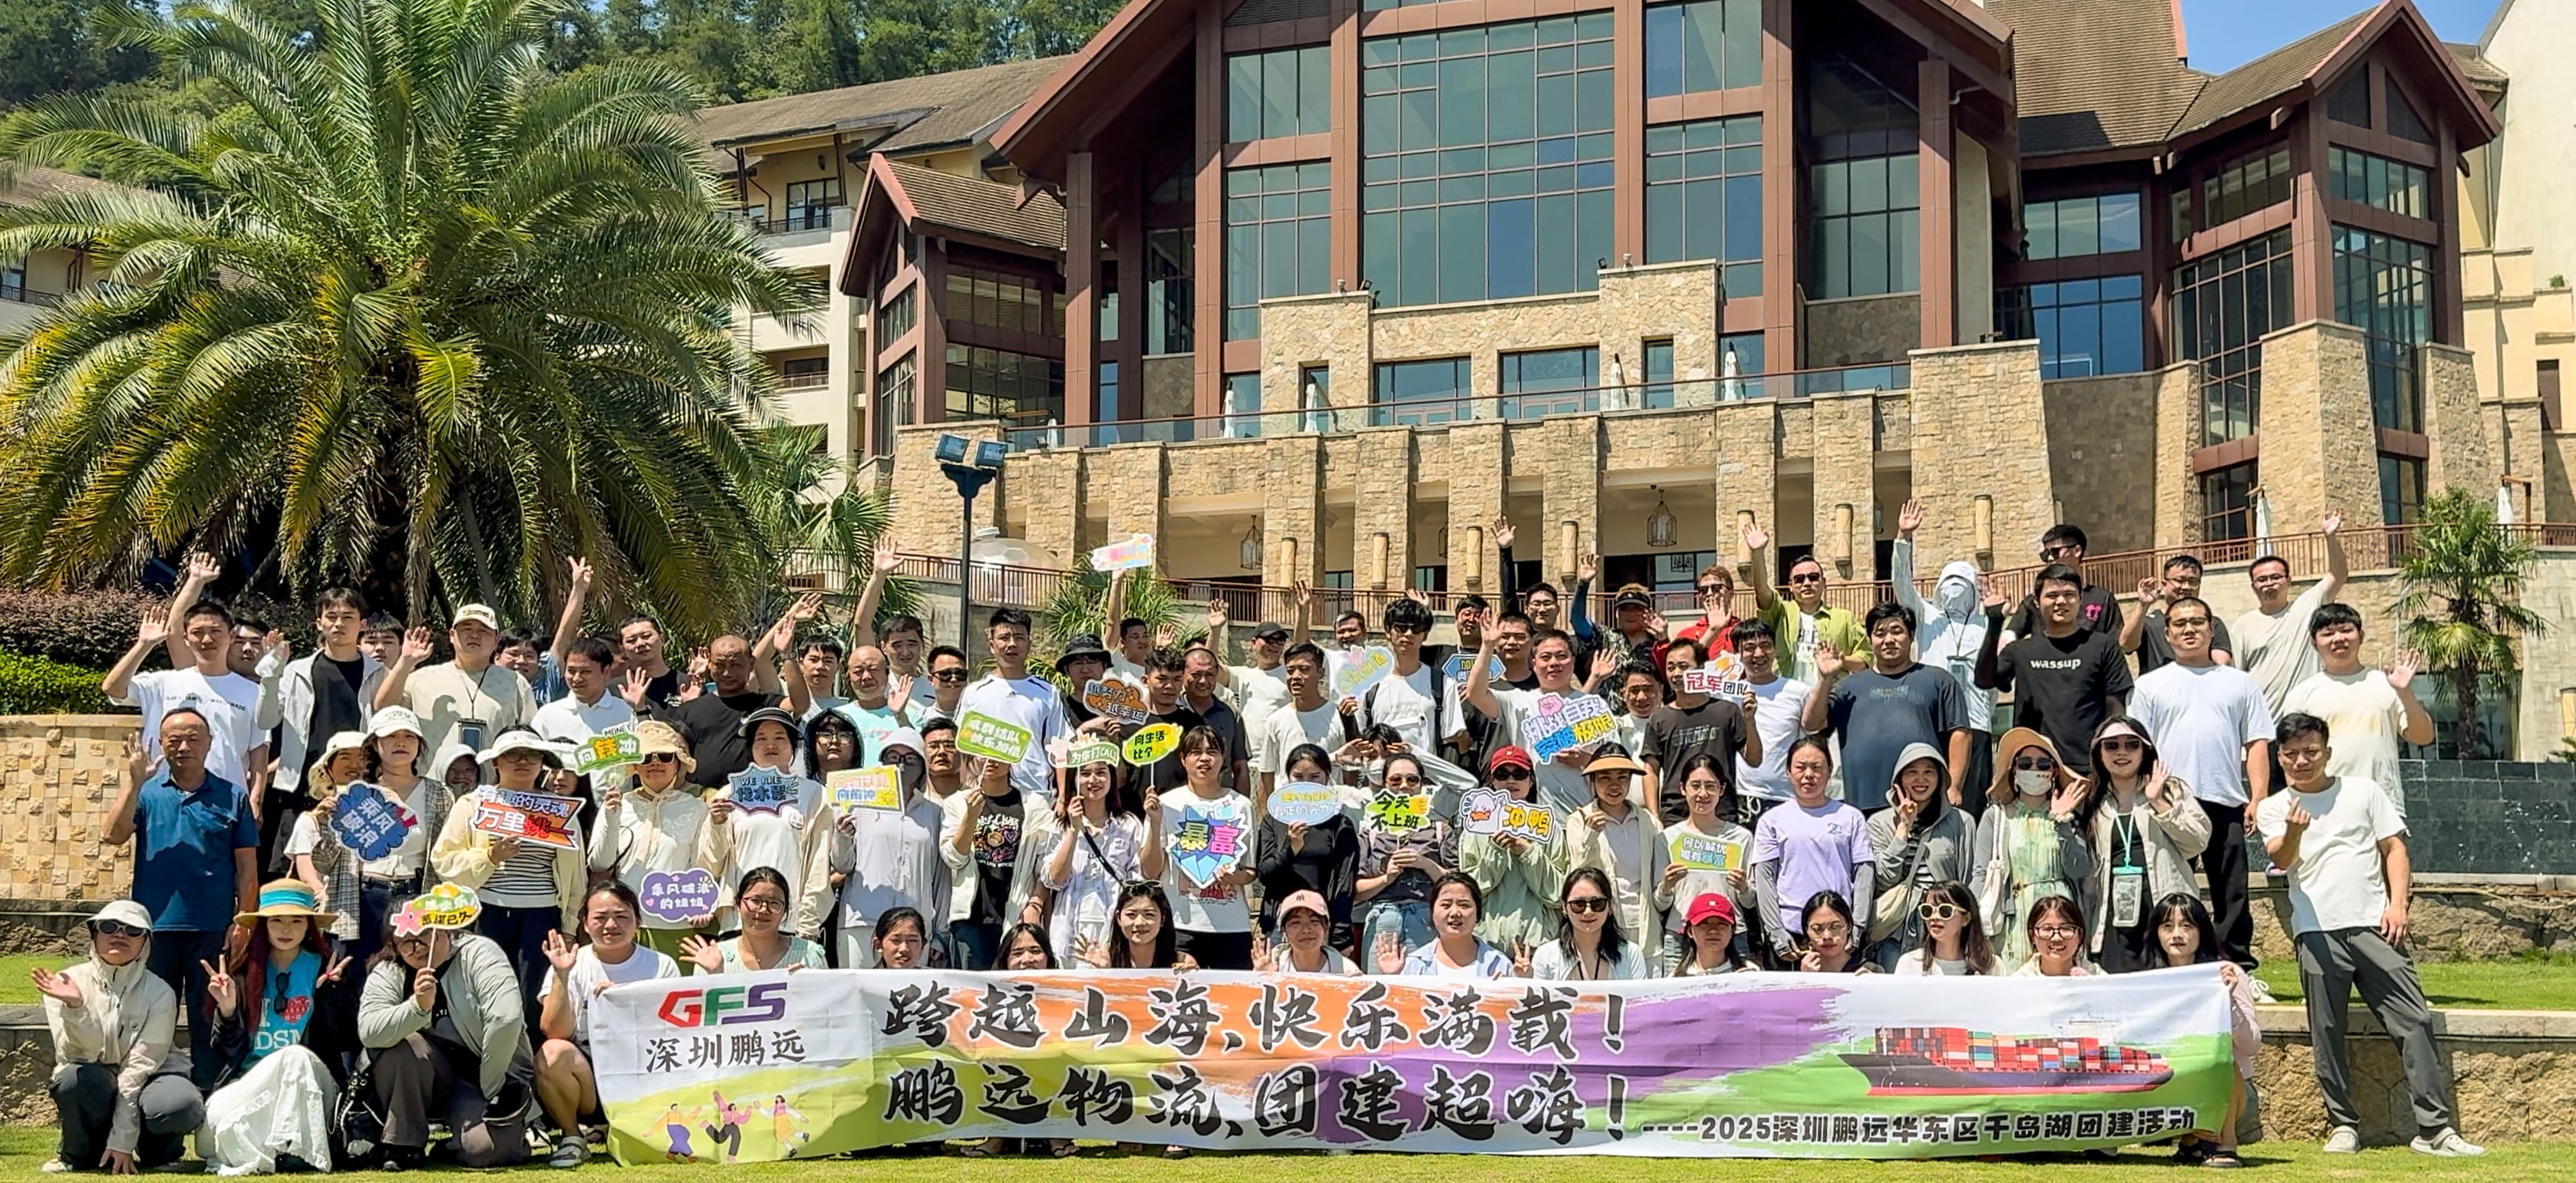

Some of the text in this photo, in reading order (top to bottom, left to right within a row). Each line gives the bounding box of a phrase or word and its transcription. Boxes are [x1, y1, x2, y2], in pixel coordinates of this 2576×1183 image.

[2030, 659, 2081, 670] wassup
[1105, 702, 1145, 721] 越幸运
[1523, 696, 1604, 747] 挑战自我
[1134, 730, 1165, 746] 向生活
[1534, 711, 1616, 763] 突破极限
[1071, 746, 1117, 765] 为你打CALL
[1133, 746, 1153, 760] 比个
[480, 787, 569, 818] 有趣的灵魂
[1374, 790, 1410, 811] 今天
[473, 806, 575, 839] 万里挑一
[1370, 812, 1420, 832] 不上班
[1502, 805, 1551, 838] 冲鸭
[1179, 821, 1240, 855] 暴富
[1683, 837, 1727, 855] 何以解忧
[651, 882, 711, 897] 乘风破浪
[659, 897, 704, 910] 的姐姐
[658, 982, 788, 1028] GFS
[645, 1029, 806, 1073] 深圳鹏远
